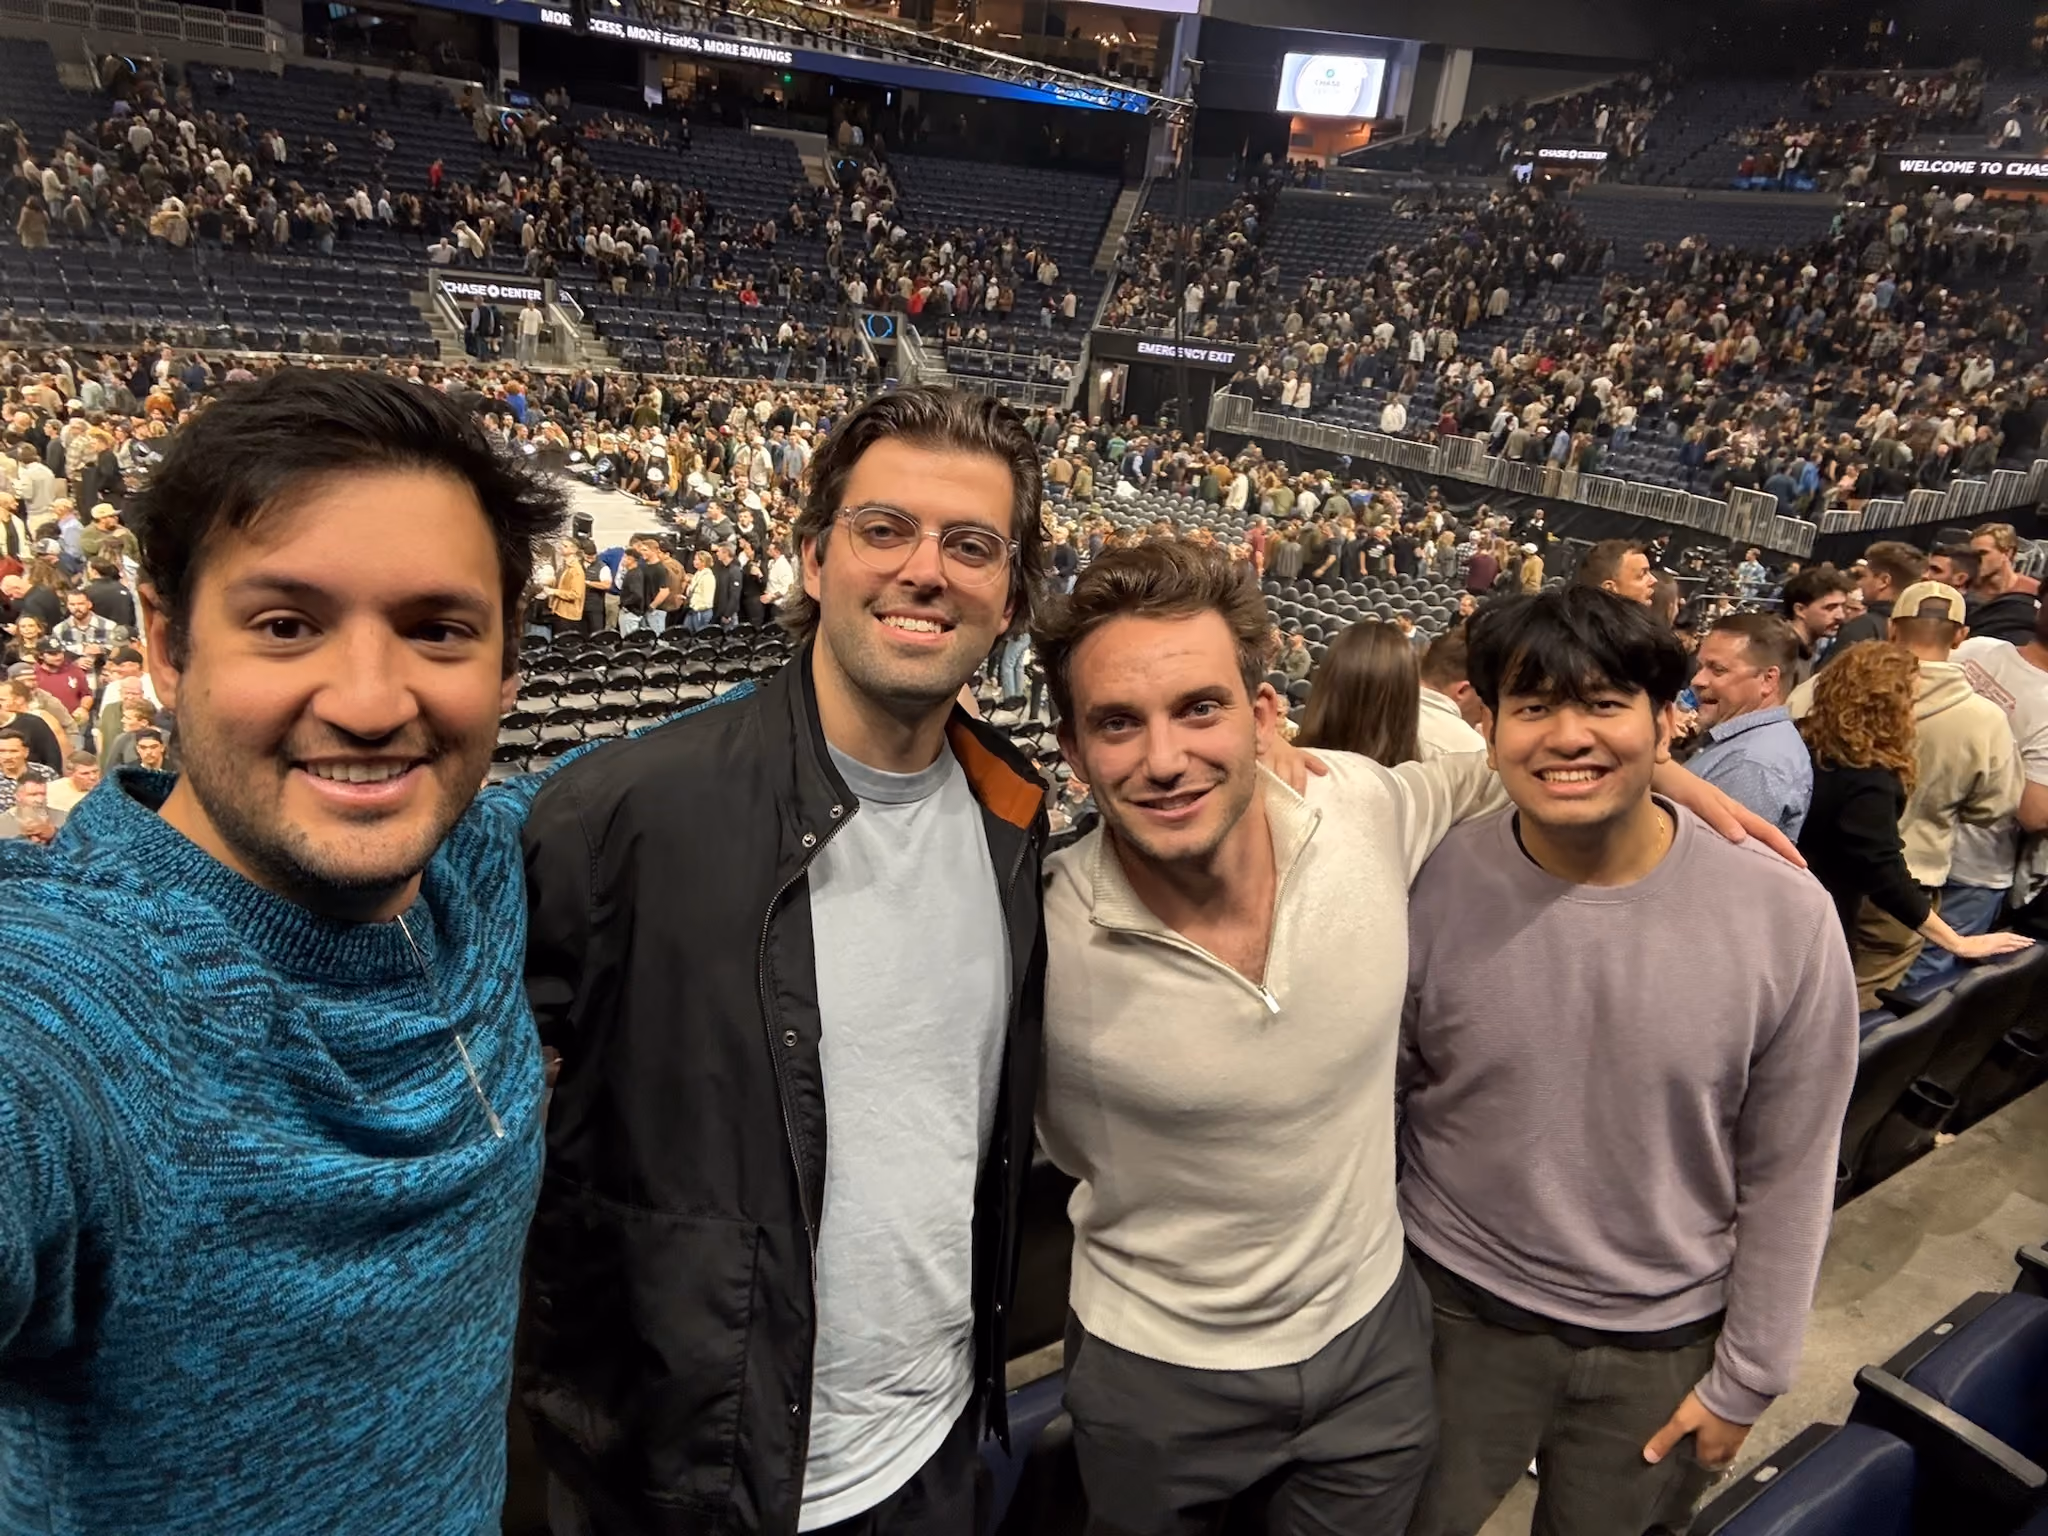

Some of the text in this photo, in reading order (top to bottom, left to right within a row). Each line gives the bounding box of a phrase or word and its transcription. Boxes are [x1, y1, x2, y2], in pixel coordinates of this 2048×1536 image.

[541, 8, 573, 27] MOR
[627, 25, 661, 43] MORE
[703, 39, 739, 56] MORE
[740, 45, 793, 63] SAVINGS
[1539, 149, 1608, 160] CHASE CENTER
[1900, 160, 1977, 174] WELCOME
[1980, 161, 2003, 175] TO
[444, 281, 487, 296] CHASE
[500, 287, 542, 301] CENTER
[1137, 342, 1236, 364] EMERGENCY EXIT
